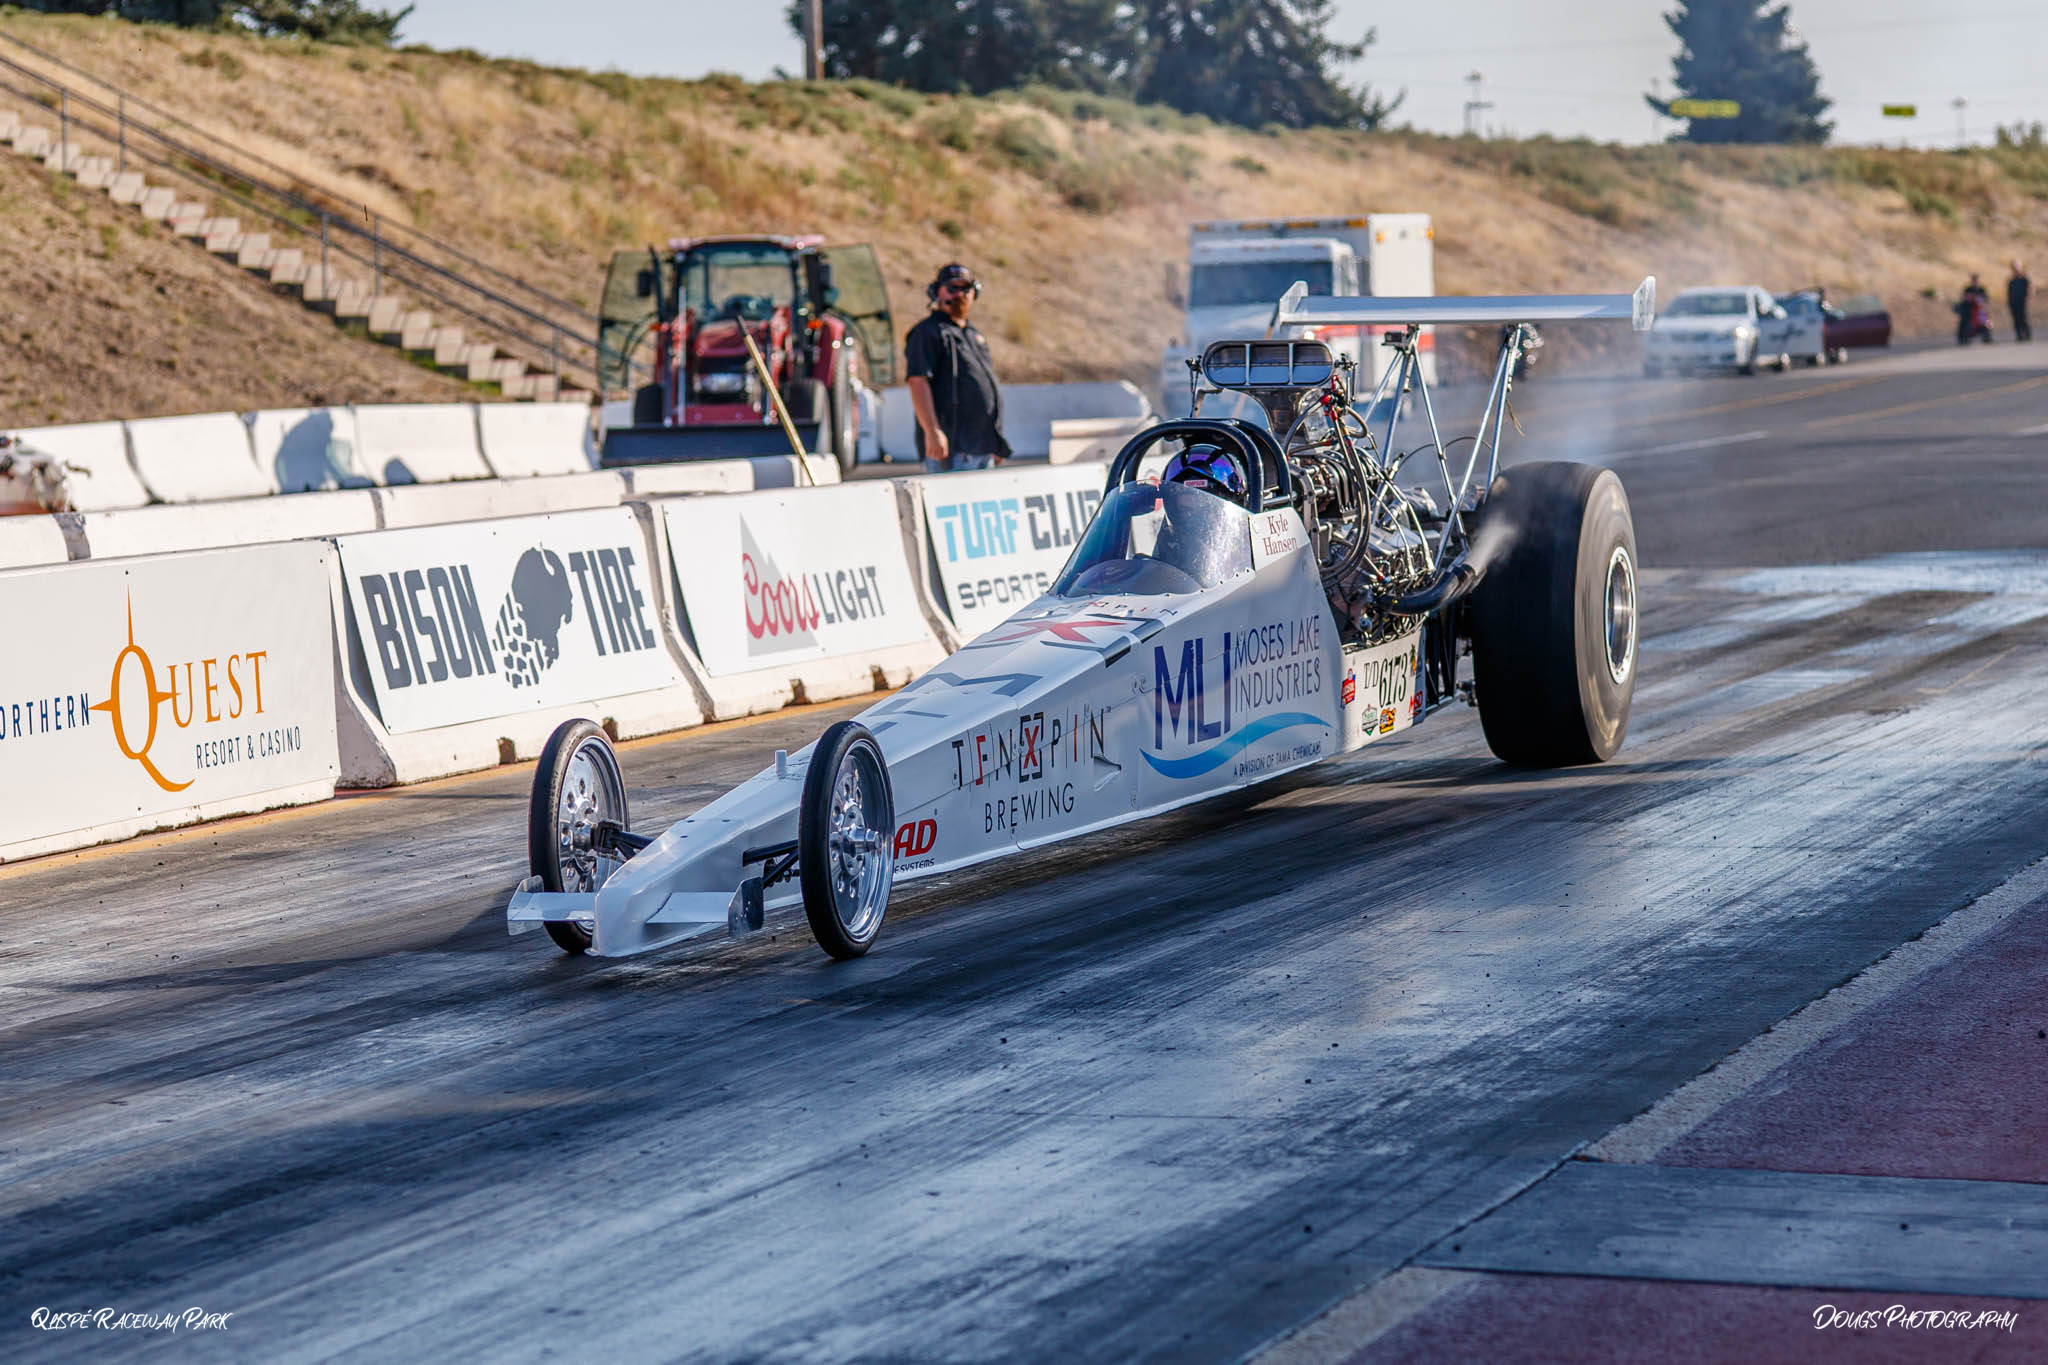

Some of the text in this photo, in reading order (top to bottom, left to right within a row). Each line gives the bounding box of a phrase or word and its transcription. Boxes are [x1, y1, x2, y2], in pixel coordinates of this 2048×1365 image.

[936, 498, 1020, 563] TURF
[1263, 536, 1298, 557] Hansen
[1267, 514, 1289, 536] Kyle
[360, 547, 657, 690] BISON TIRE
[742, 552, 885, 639] Coors LIGHT
[1234, 614, 1319, 670] MOSES LAKE
[1154, 632, 1231, 750] MLI
[1234, 656, 1321, 713] INDUSTRIES
[1379, 652, 1408, 709] 6173
[196, 725, 301, 770] RESORT & CASINO
[985, 782, 1074, 834] BREWING
